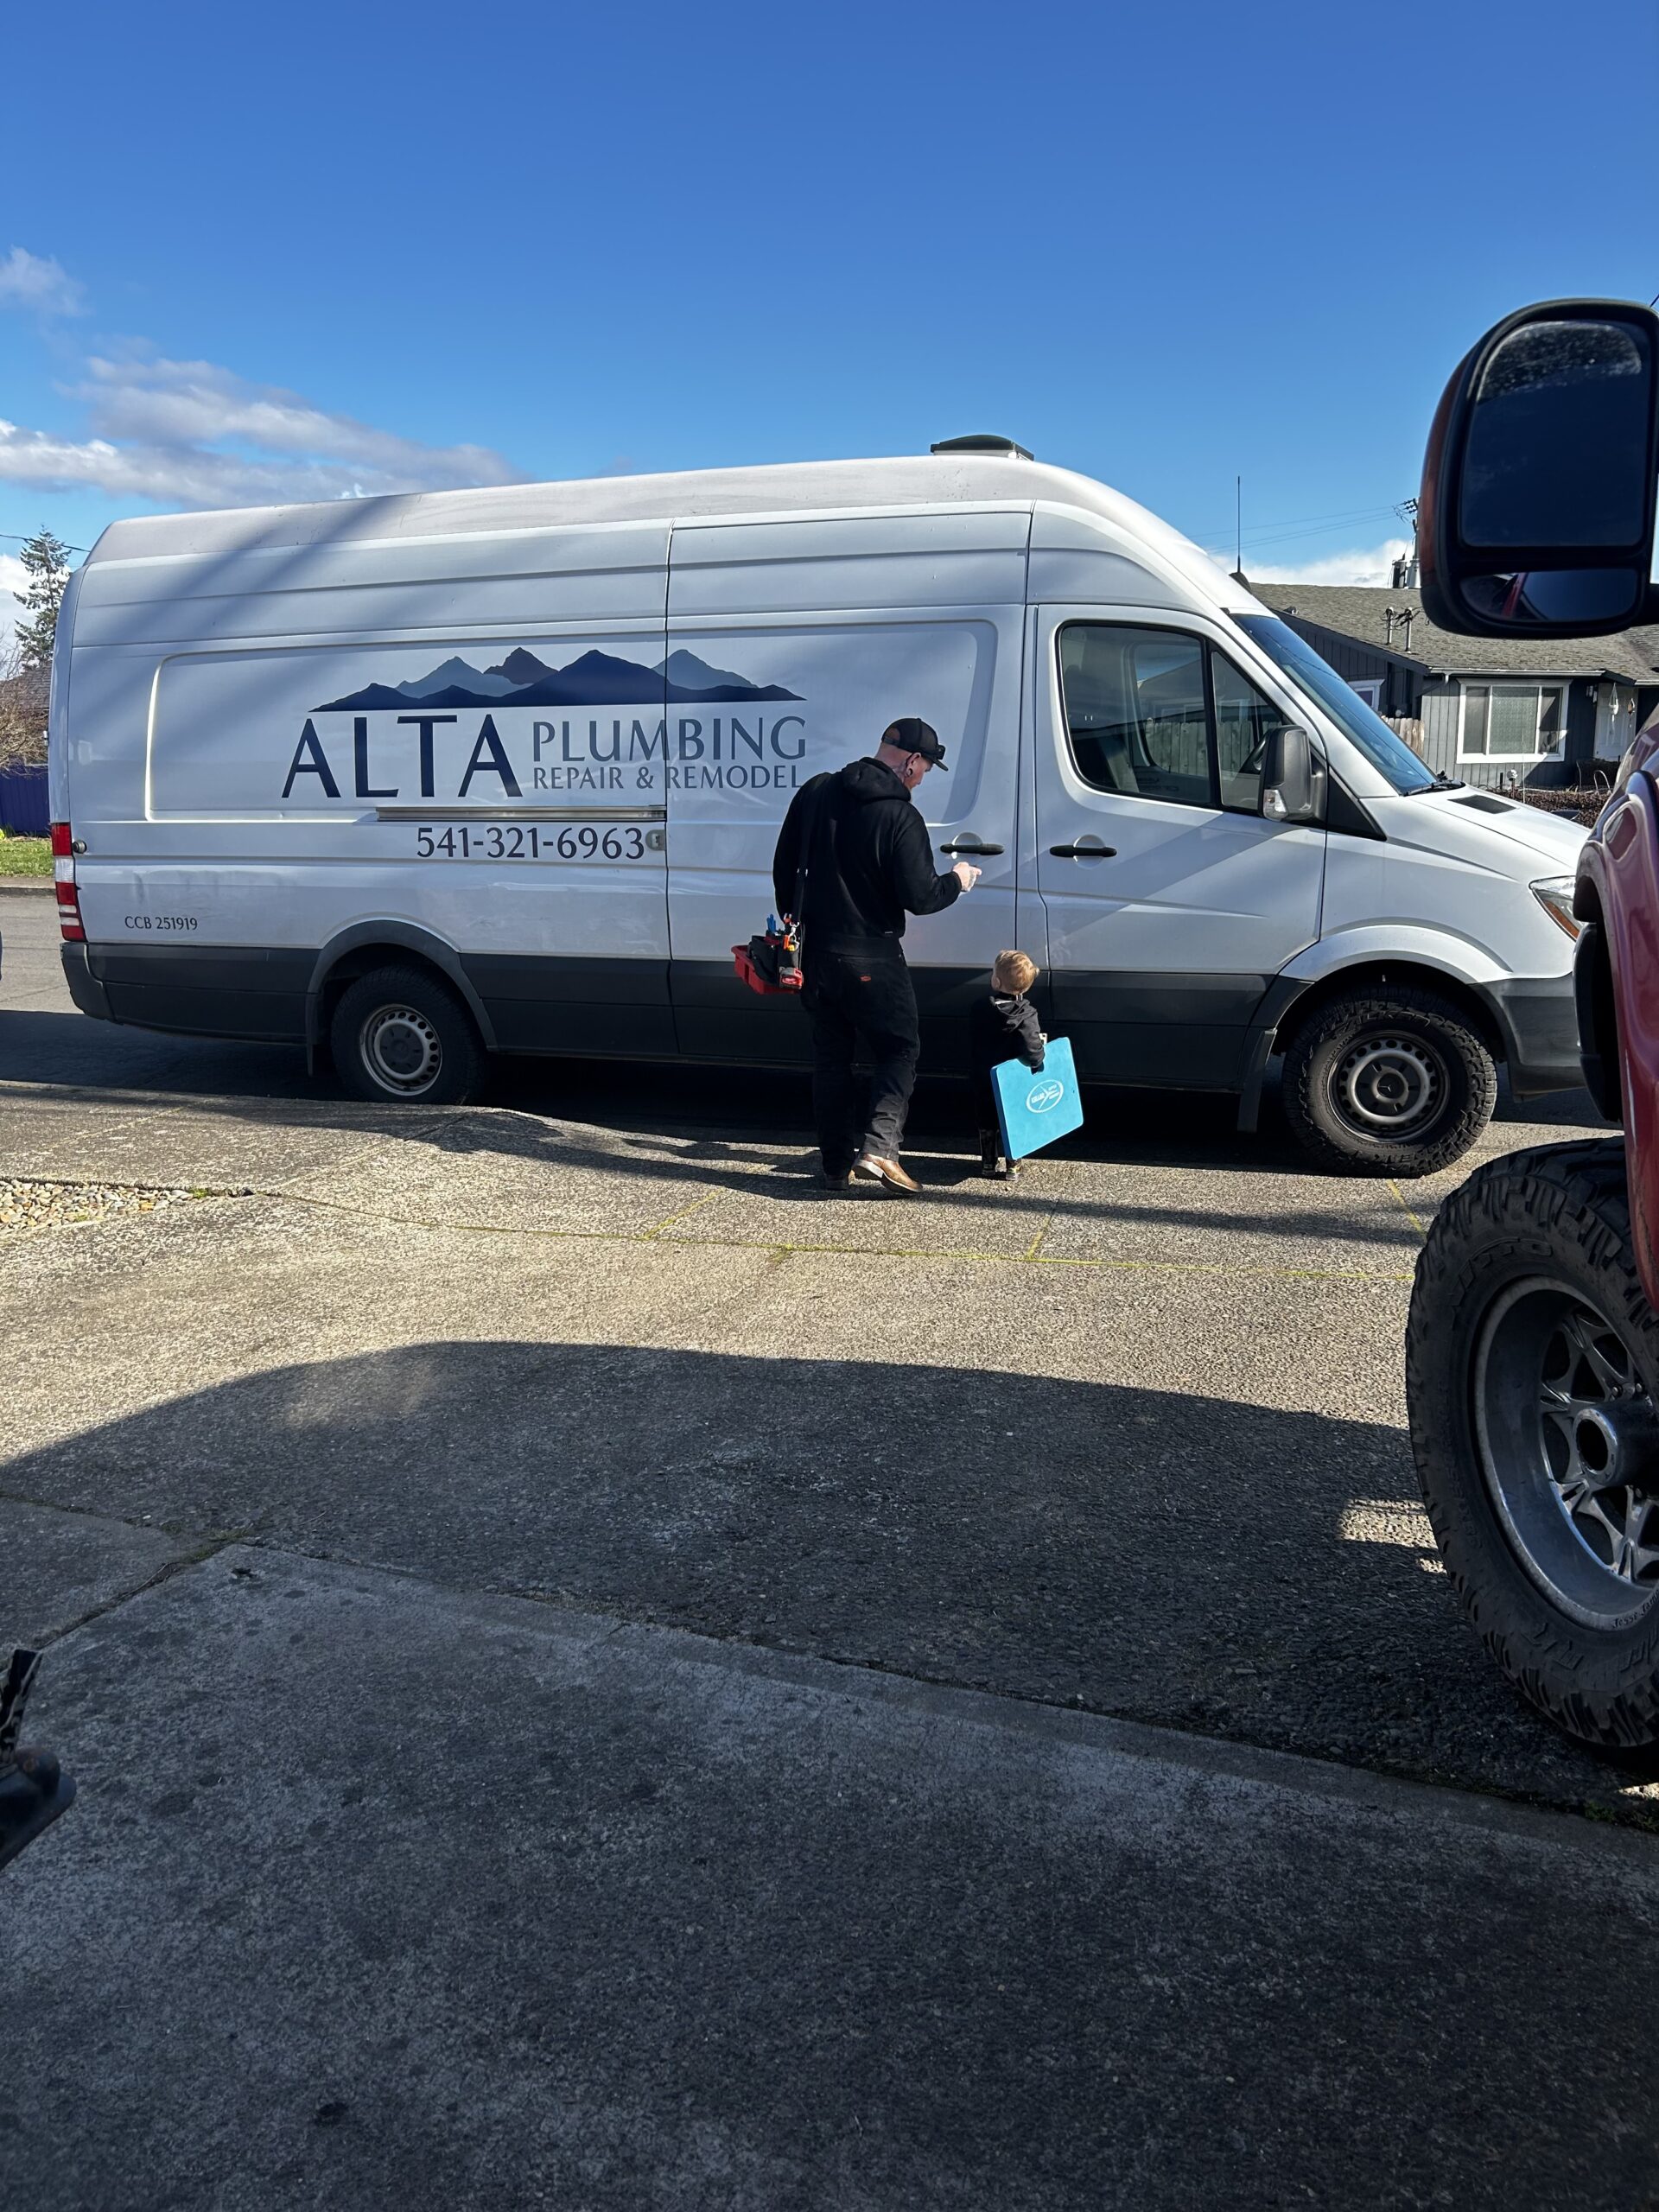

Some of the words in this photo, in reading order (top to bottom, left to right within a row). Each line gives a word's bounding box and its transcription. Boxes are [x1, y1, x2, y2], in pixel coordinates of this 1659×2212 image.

[533, 716, 806, 762] PLUMBING
[282, 714, 524, 798] ALTA
[533, 767, 624, 791] REPAIR
[637, 767, 654, 790] &
[668, 765, 803, 789] REMODEL
[417, 827, 645, 859] 541-321-6963
[124, 916, 152, 930] CCB
[156, 917, 198, 931] 251919
